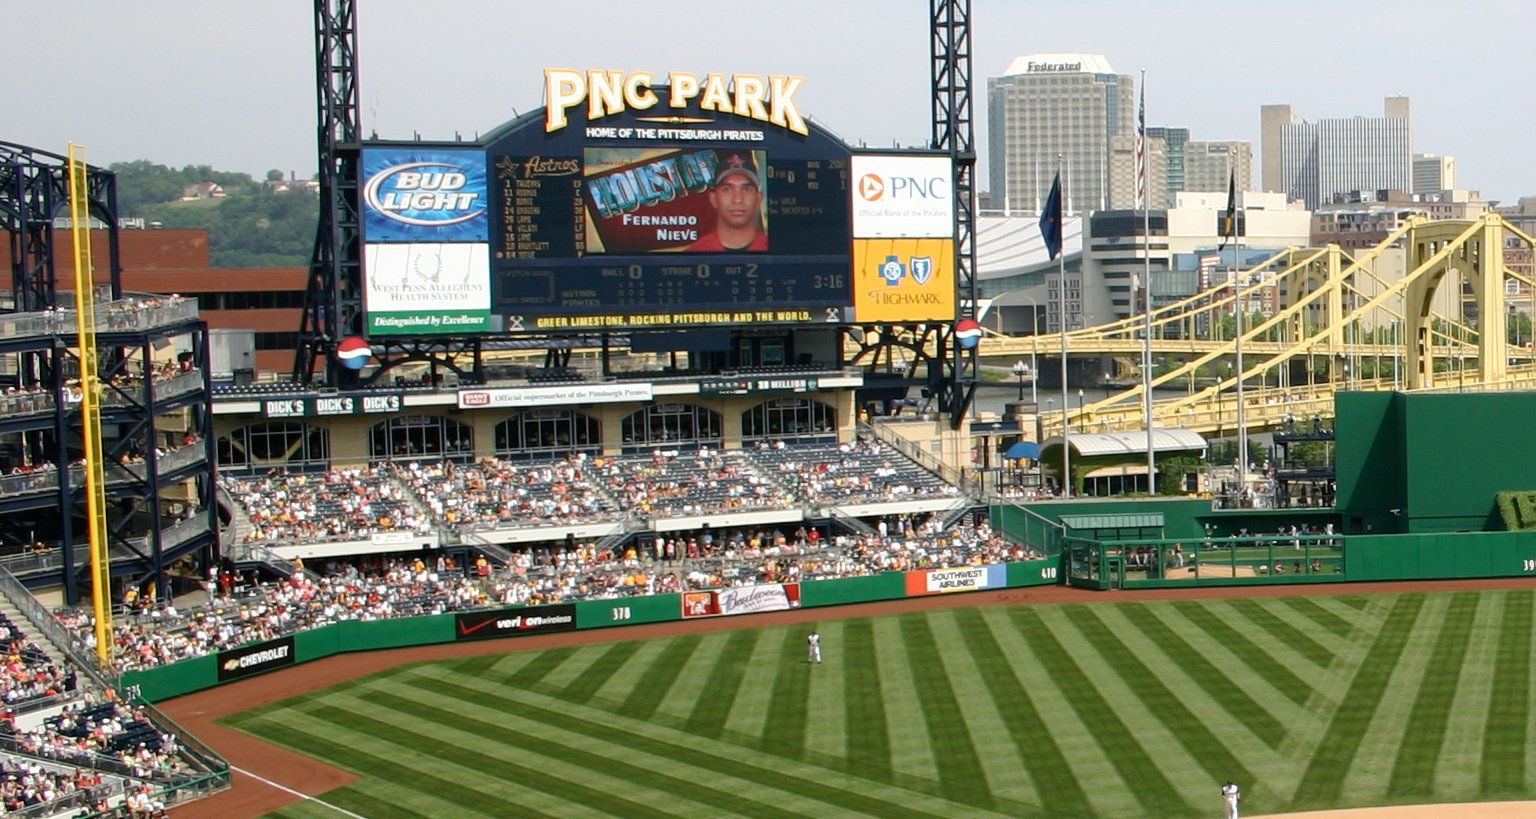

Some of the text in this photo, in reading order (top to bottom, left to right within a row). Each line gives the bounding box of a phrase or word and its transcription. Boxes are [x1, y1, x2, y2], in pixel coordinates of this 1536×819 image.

[1026, 62, 1081, 72] Federated
[544, 68, 810, 136] PNC PARK
[586, 128, 764, 141] HOME OF THE PITTSBURGH PIRATES
[524, 156, 580, 178] Astros
[396, 172, 467, 190] BUD
[889, 176, 946, 200] PNC
[383, 193, 479, 210] LIGHT
[623, 214, 698, 226] FERNANDO
[746, 263, 758, 278] 2
[814, 274, 843, 288] 3:16
[868, 288, 942, 304] HIGHMARK
[374, 316, 484, 328] Distinguished by Excellence
[537, 317, 568, 328] GREER
[674, 312, 730, 324] PITTSBURGH
[734, 312, 750, 322] AND
[756, 312, 774, 322] THE
[266, 400, 304, 414] DICK'S
[316, 398, 354, 412] DICK'S
[364, 395, 399, 411] DICK'S
[932, 570, 983, 582] SOUTHWEST
[1041, 568, 1056, 578] 410
[938, 579, 975, 588] AIRLINES
[612, 607, 631, 620] 378
[240, 646, 289, 668] CHEVROLET
